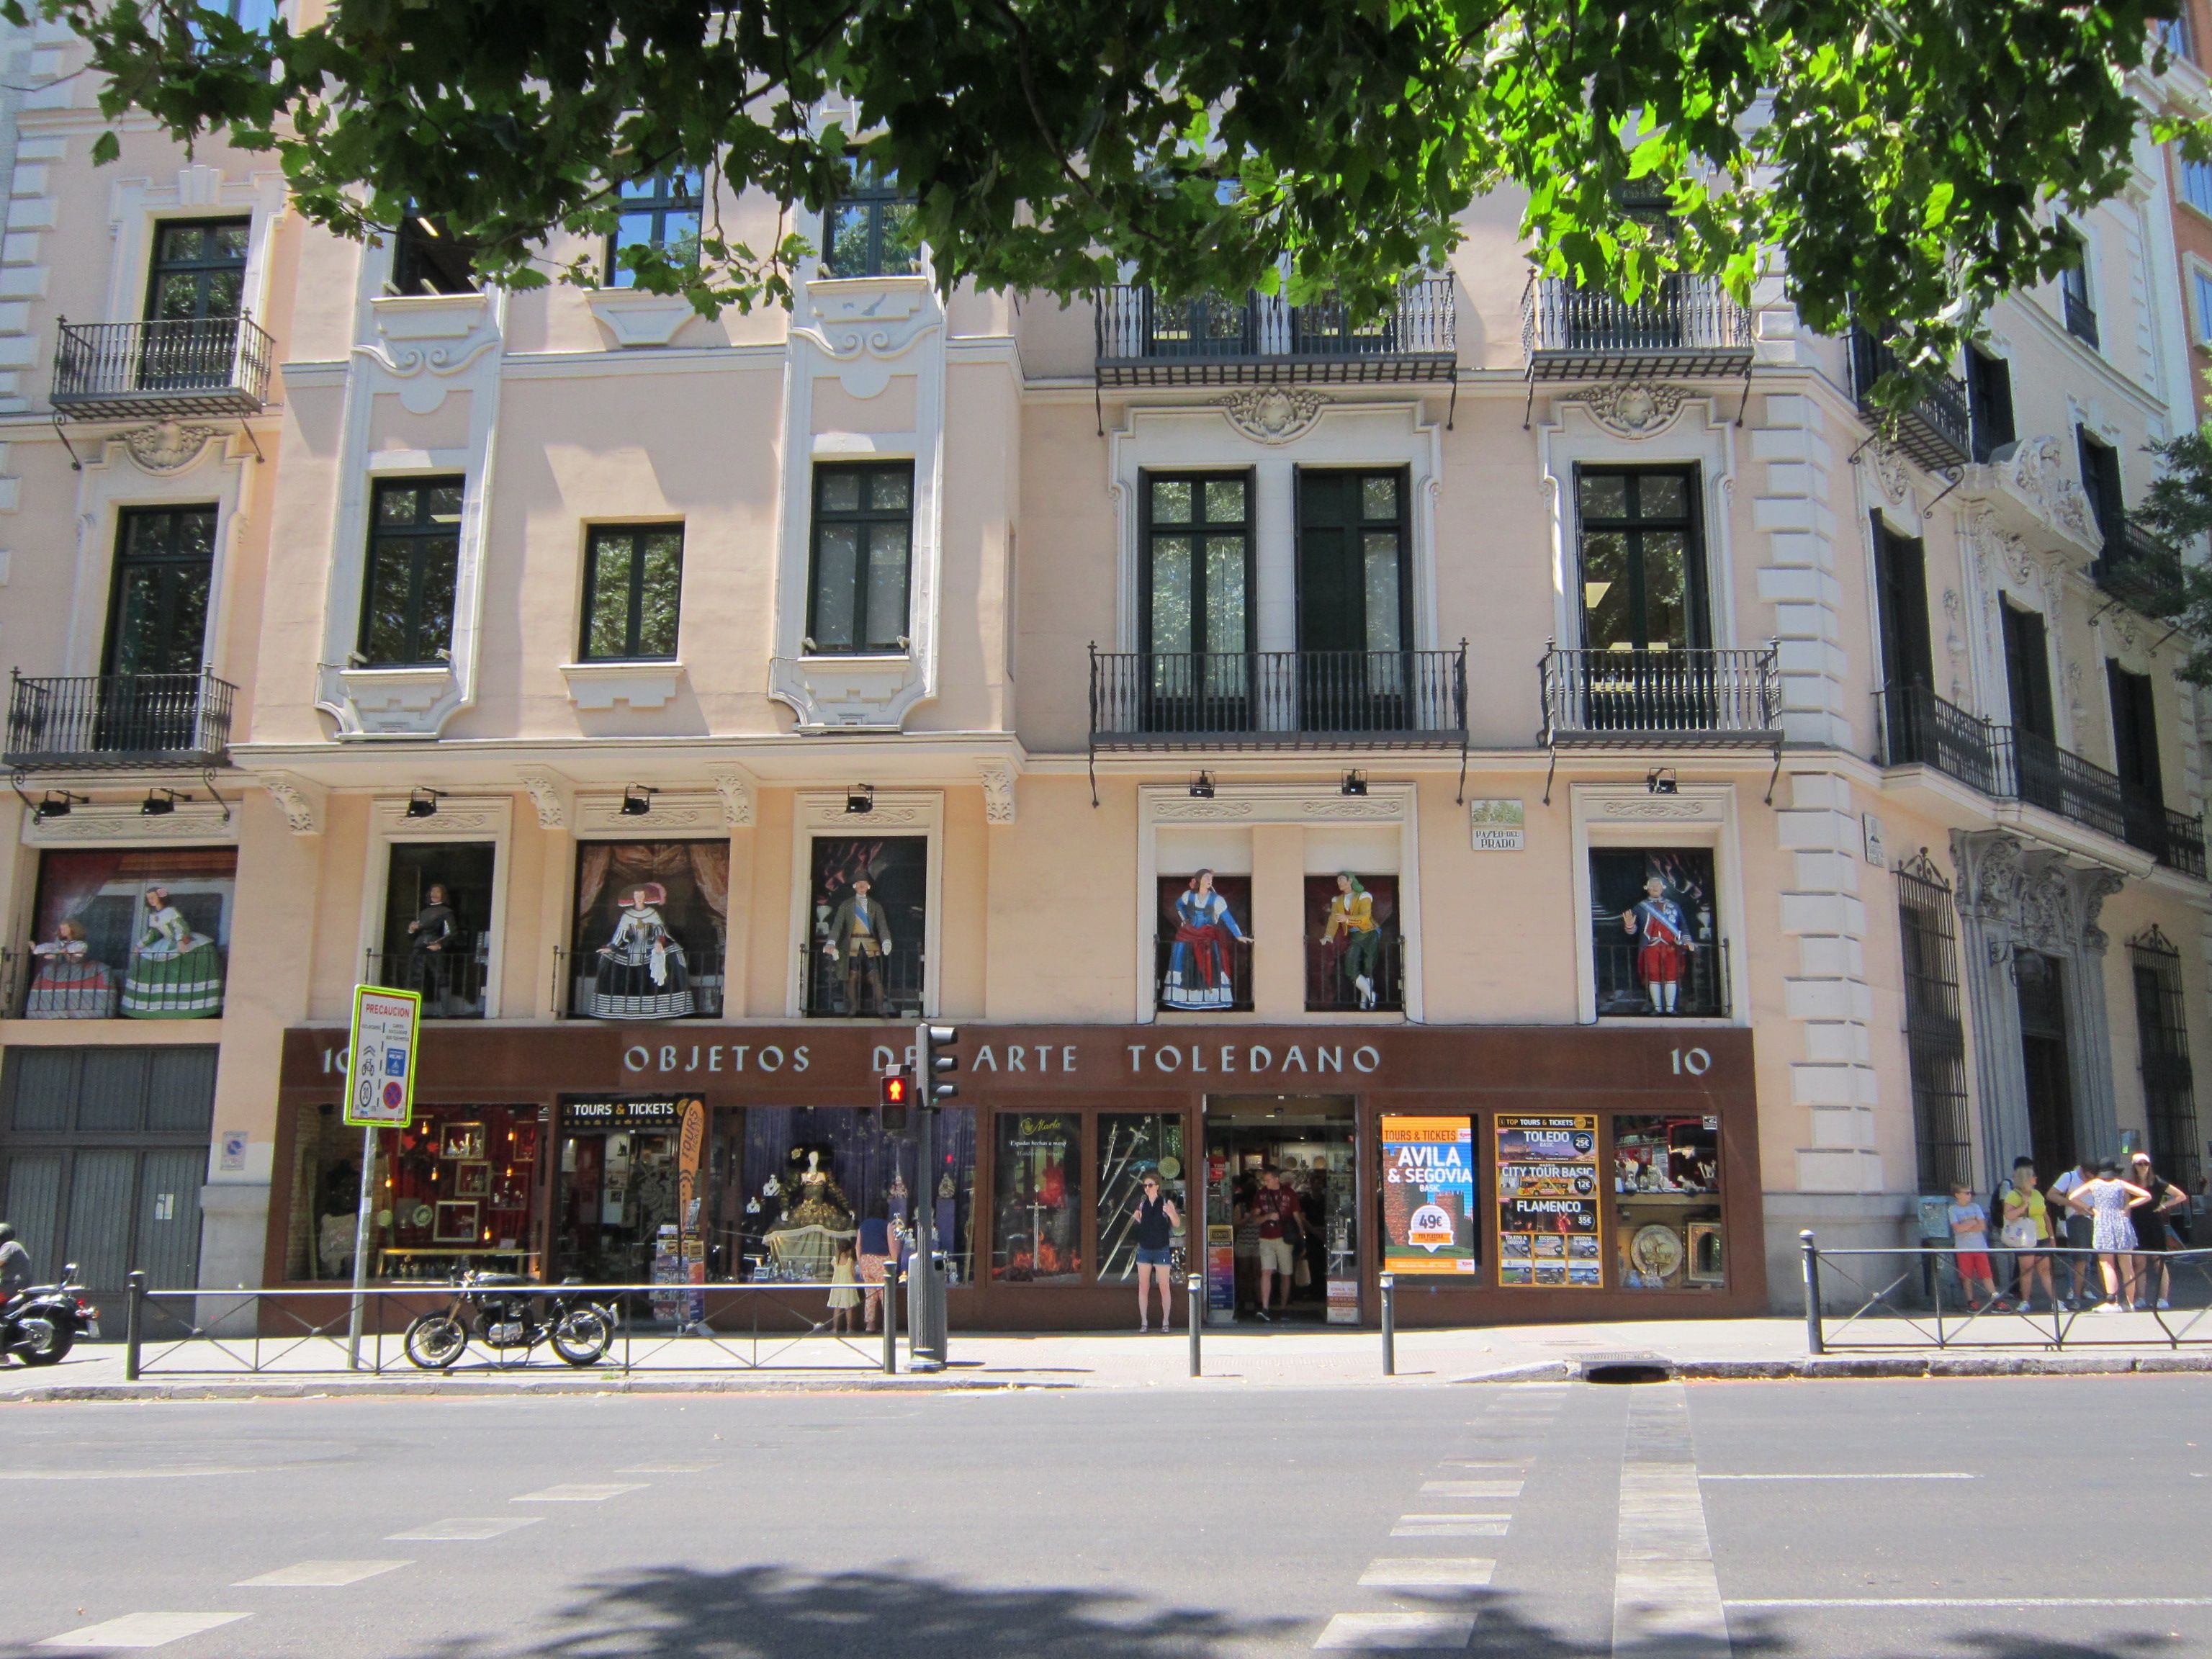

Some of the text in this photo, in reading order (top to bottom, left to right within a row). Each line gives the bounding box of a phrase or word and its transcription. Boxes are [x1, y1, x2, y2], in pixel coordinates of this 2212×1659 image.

[1481, 838, 1515, 849] PRADO
[624, 1045, 810, 1072] OBJETOS
[972, 1045, 1077, 1072] ARTE
[1127, 1045, 1380, 1073] TOLEDANO
[1671, 1047, 1712, 1076] 10
[574, 1103, 674, 1115] TOURS & TICKETS
[682, 1107, 698, 1158] TOURS
[1385, 1130, 1411, 1141] TOURS
[1414, 1130, 1420, 1141] &
[1423, 1130, 1456, 1141] TICKETS
[1524, 1130, 1570, 1143] TOLEDO
[1398, 1146, 1462, 1167] AVILA
[1388, 1168, 1473, 1183] & SEGOVIA
[1502, 1166, 1593, 1178] CITY TOUR BASIC
[1516, 1200, 1581, 1213] FLAMENCO
[1419, 1214, 1442, 1229] 49€
